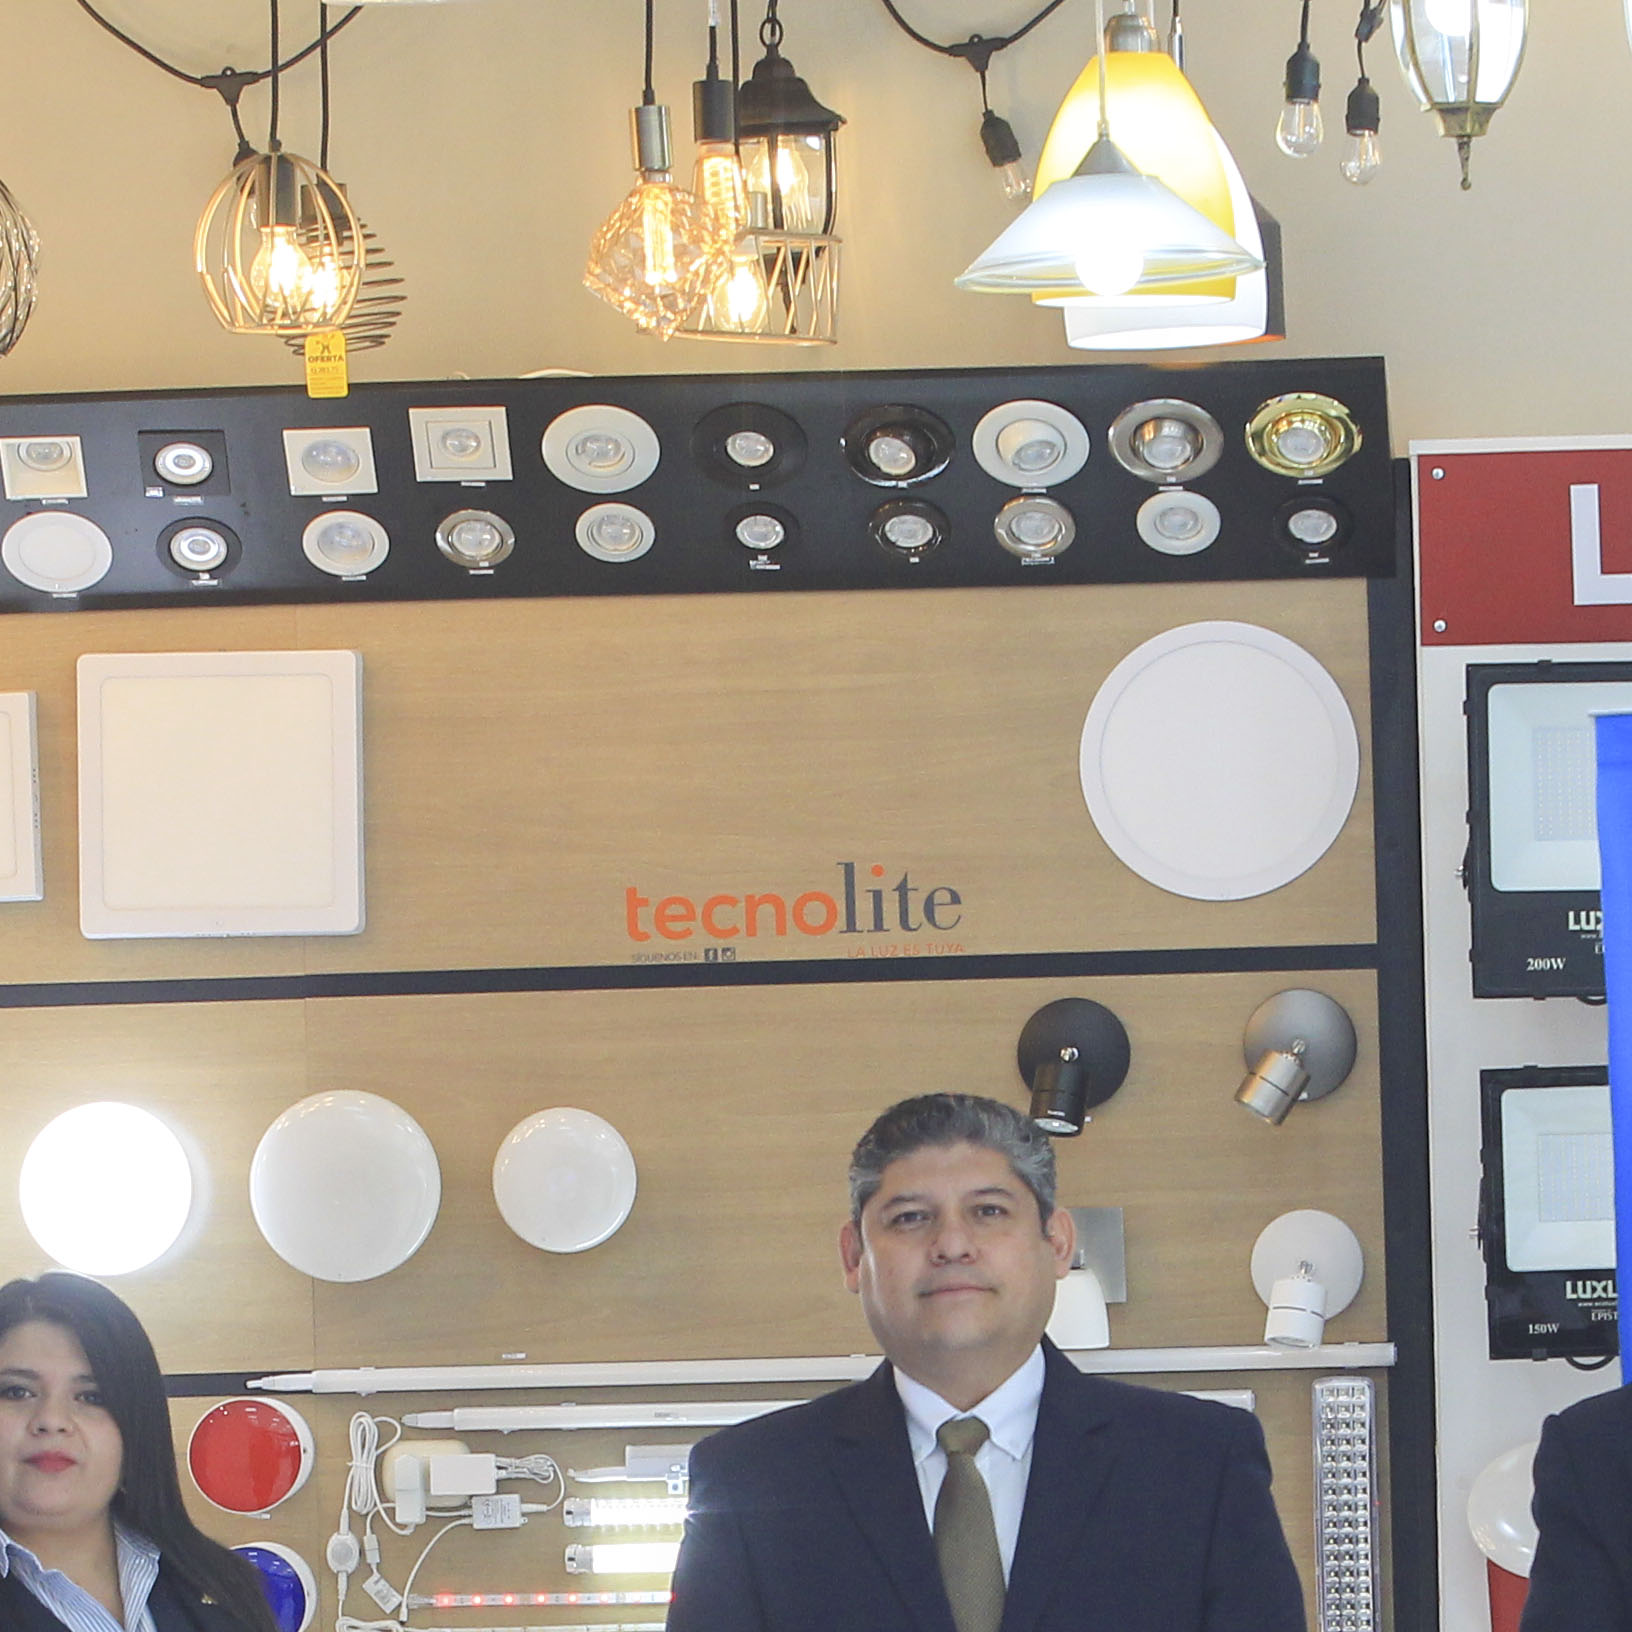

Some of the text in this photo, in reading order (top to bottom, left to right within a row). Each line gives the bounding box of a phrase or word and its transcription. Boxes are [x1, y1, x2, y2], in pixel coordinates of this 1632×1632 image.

[308, 354, 344, 363] OFERTA
[625, 861, 963, 943] tecnolite
[848, 942, 965, 959] LA LUZ ES TUYA
[1526, 957, 1566, 971] 200W
[1565, 1279, 1618, 1299] LUXL
[1528, 1323, 1560, 1335] 150W
